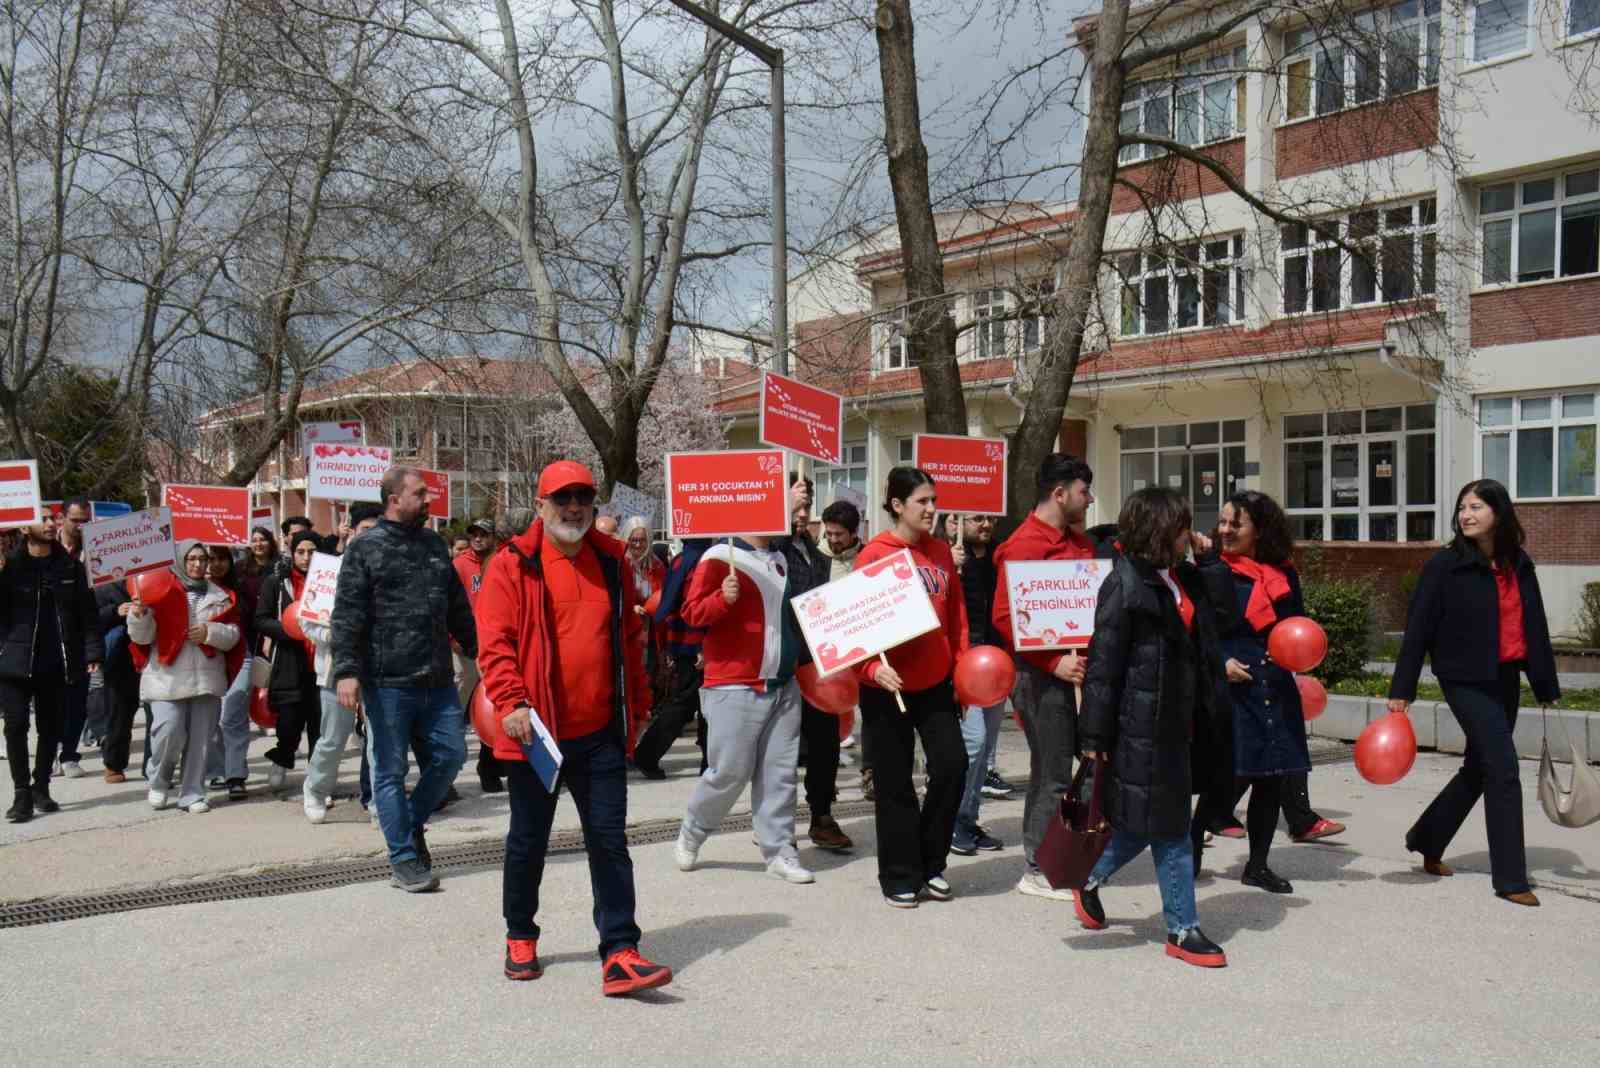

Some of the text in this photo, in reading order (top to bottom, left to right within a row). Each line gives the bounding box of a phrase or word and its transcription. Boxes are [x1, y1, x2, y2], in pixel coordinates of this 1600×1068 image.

[678, 483, 697, 493] HER
[711, 480, 762, 493] ÇOCUKTAN
[688, 494, 735, 504] FARKINDA
[1024, 596, 1097, 611] ZENGİNLİKTİ
